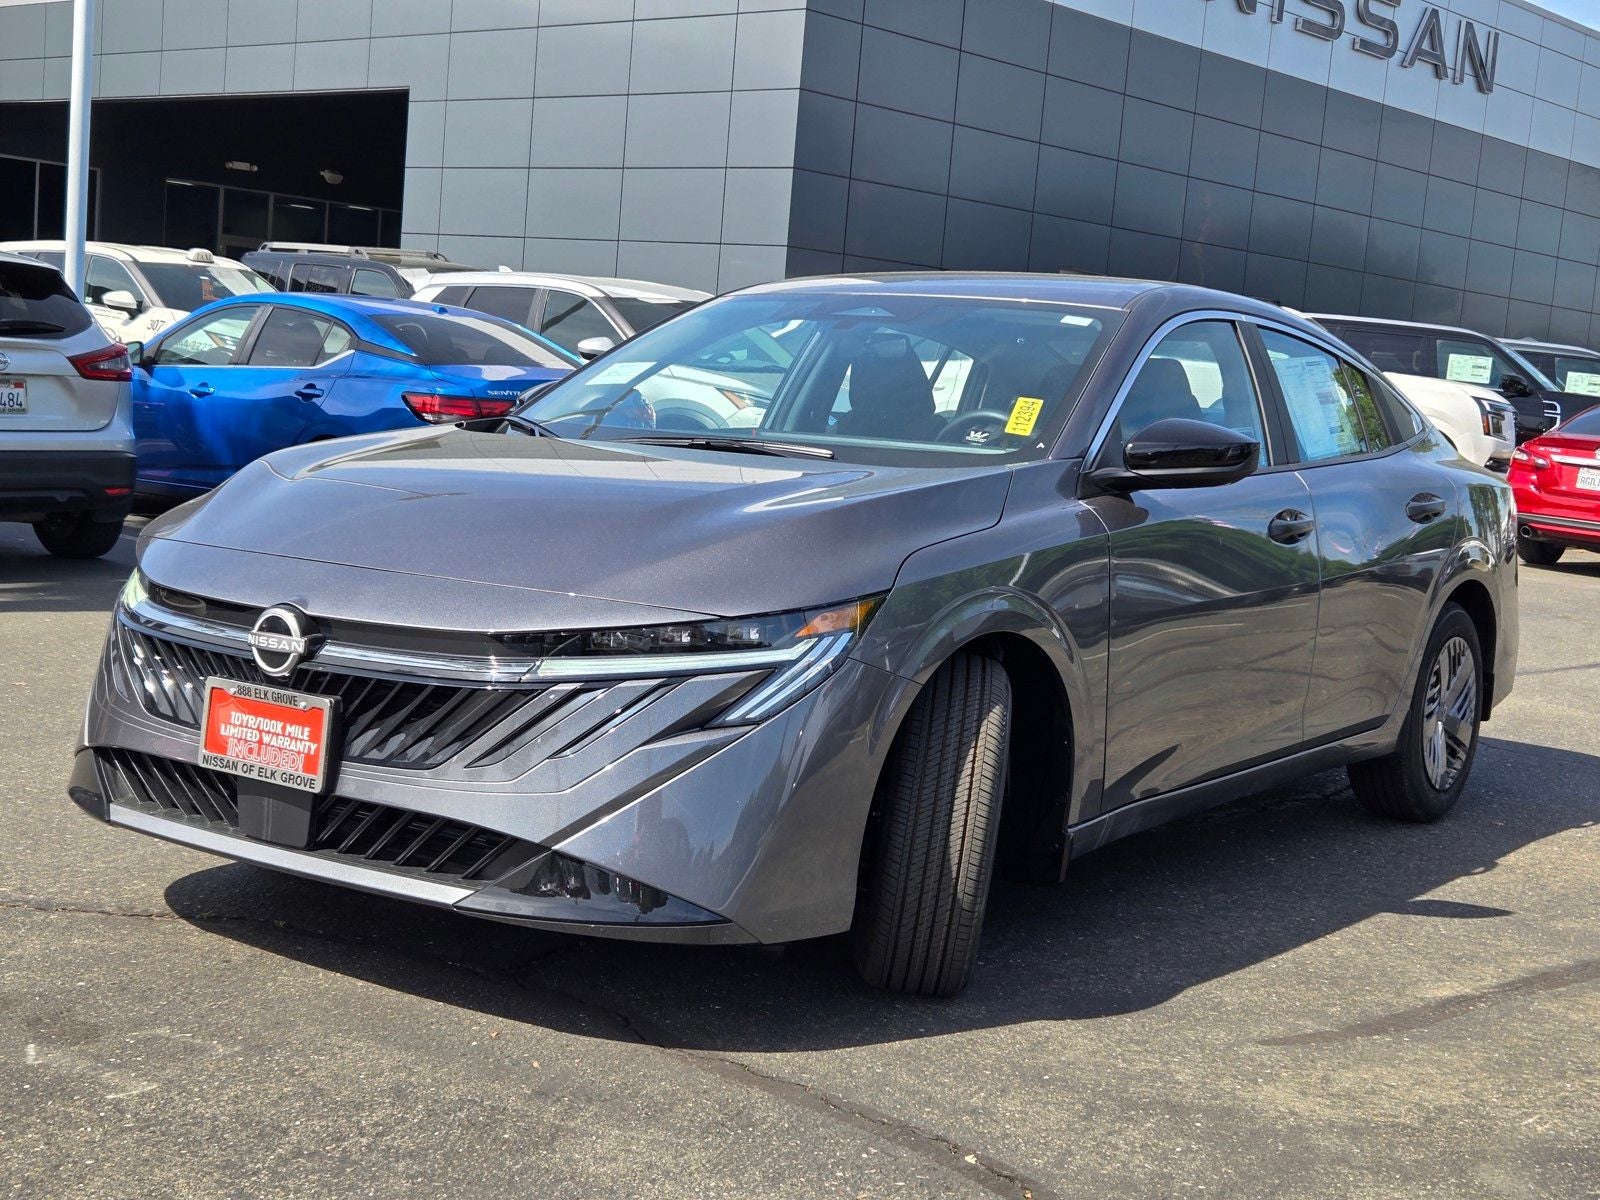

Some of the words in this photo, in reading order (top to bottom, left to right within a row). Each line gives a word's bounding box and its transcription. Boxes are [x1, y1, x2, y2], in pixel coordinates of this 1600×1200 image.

[147, 319, 166, 332] 307
[247, 633, 305, 654] NISSAN
[237, 684, 252, 698] 888
[254, 687, 270, 701] ELK
[271, 691, 299, 707] GROVE
[220, 723, 260, 743] LIMITED
[262, 731, 318, 755] WARRANTY
[230, 711, 284, 735] 10YR/100K
[285, 723, 311, 741] MILE
[226, 737, 304, 773] INCLUDED!
[202, 754, 238, 772] NISSAN
[241, 763, 255, 775] OF
[257, 766, 277, 781] ELK
[280, 772, 317, 790] GROVE
